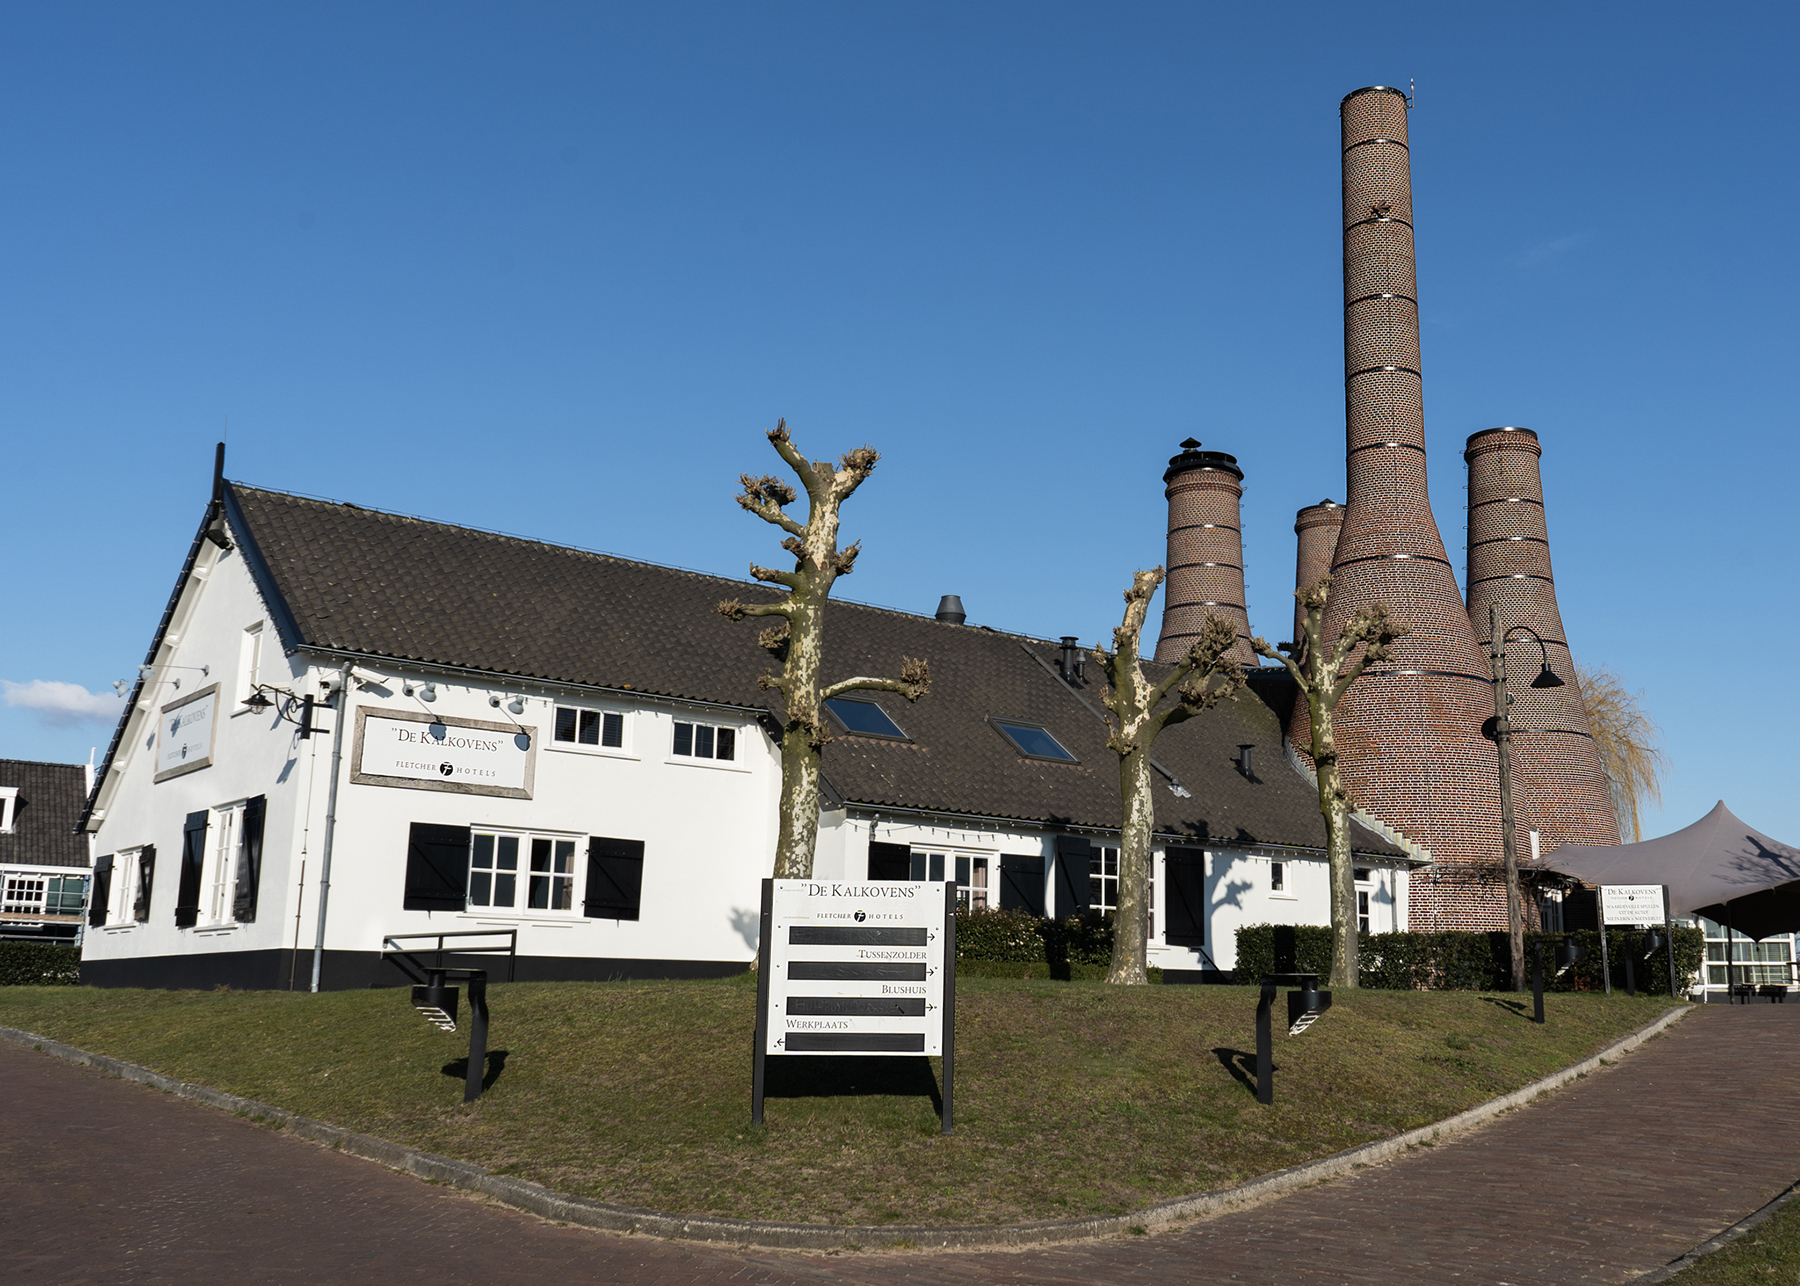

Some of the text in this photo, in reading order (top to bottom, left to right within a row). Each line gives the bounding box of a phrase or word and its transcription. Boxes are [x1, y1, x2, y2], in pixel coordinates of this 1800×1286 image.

[395, 760, 496, 777] FLETCHER HOTELS
[858, 949, 927, 960] TUSSENZOLDER
[881, 984, 927, 995] BLUSHUIS
[786, 1019, 849, 1029] WERKPLAATS
